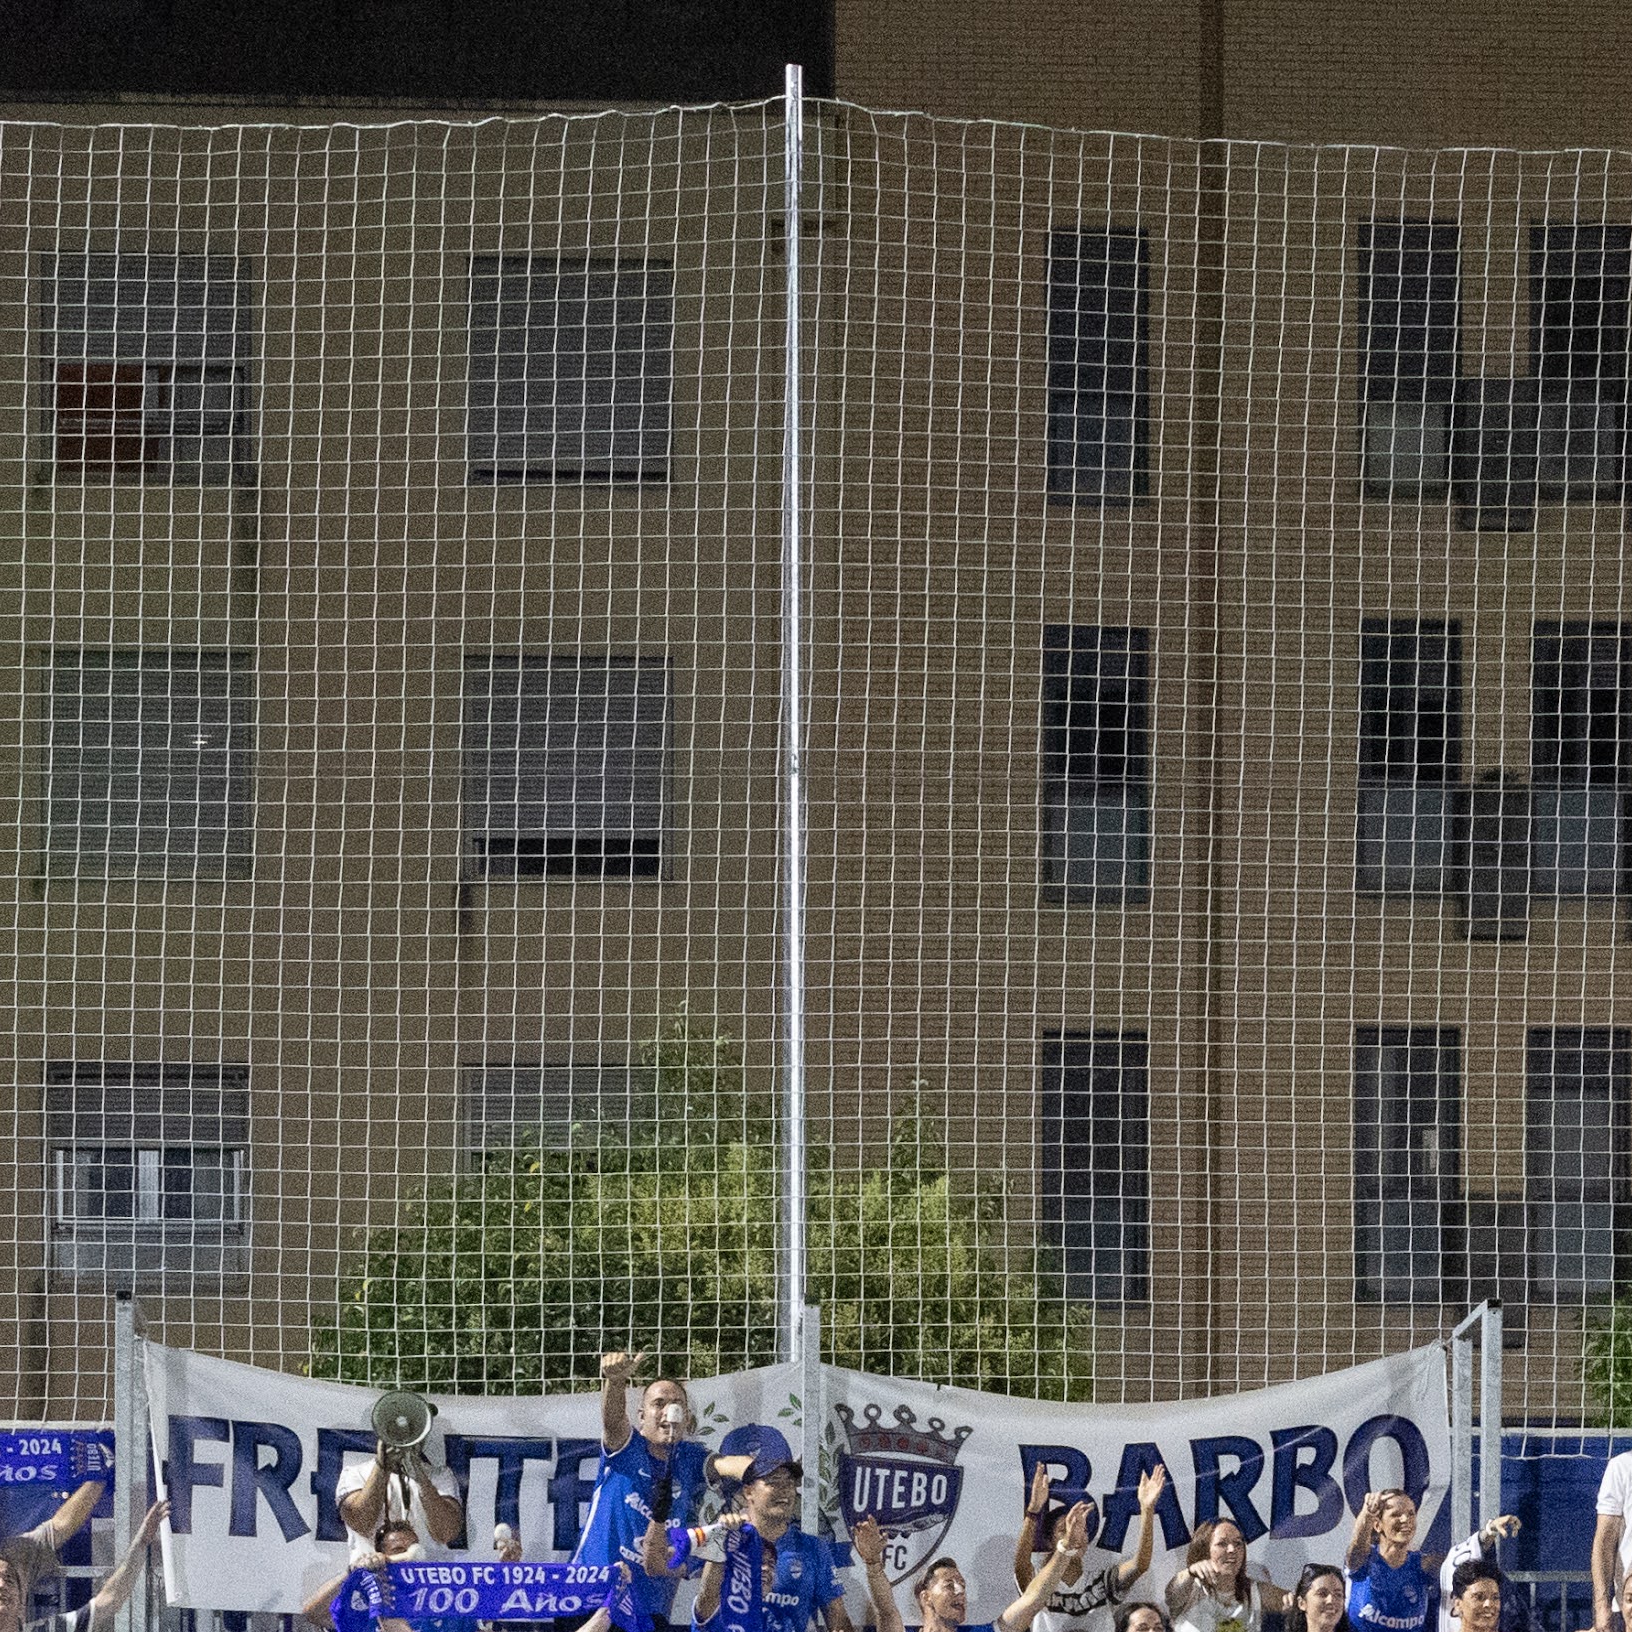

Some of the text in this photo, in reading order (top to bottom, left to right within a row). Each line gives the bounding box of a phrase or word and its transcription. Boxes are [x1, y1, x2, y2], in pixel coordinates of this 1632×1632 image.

[18, 1438, 62, 1456] 2024
[853, 1466, 948, 1513] UTEBO
[1018, 1413, 1430, 1553] BARBO
[882, 1543, 908, 1571] FC
[400, 1566, 466, 1586] UTEBO
[473, 1566, 496, 1585] FC
[501, 1566, 546, 1585] 1924
[564, 1565, 610, 1584] 2024
[408, 1586, 481, 1614] 100
[1357, 1603, 1425, 1630] Alcampo
